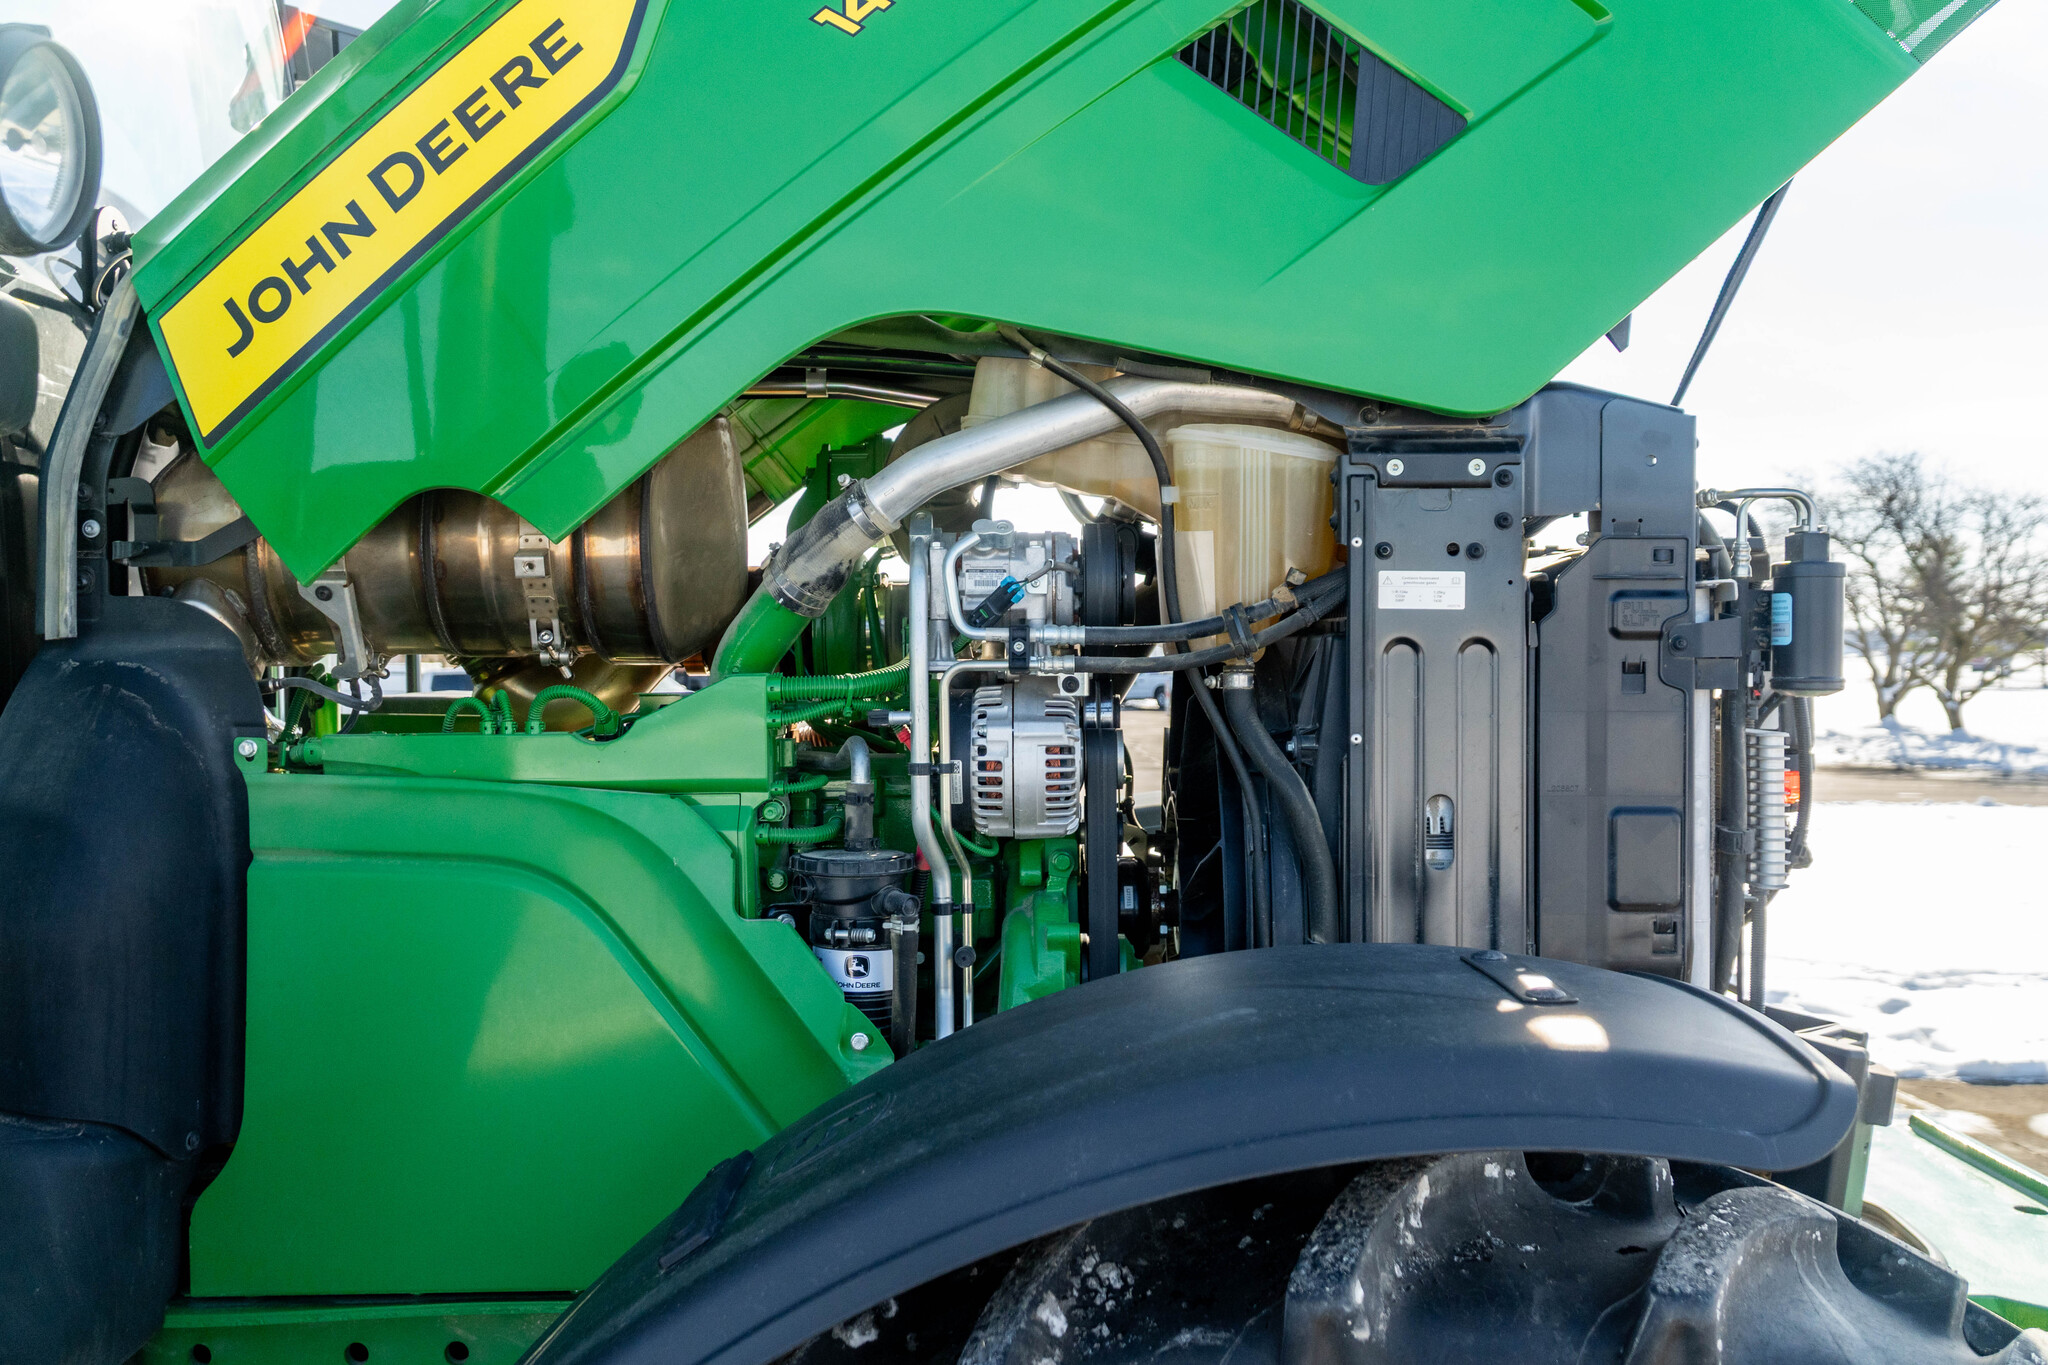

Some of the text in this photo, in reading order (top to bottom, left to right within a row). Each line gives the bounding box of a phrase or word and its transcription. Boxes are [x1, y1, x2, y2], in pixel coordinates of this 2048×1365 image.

[222, 17, 584, 359] JOHN DEERE
[1622, 601, 1658, 614] PULL
[855, 981, 881, 989] DEERE
